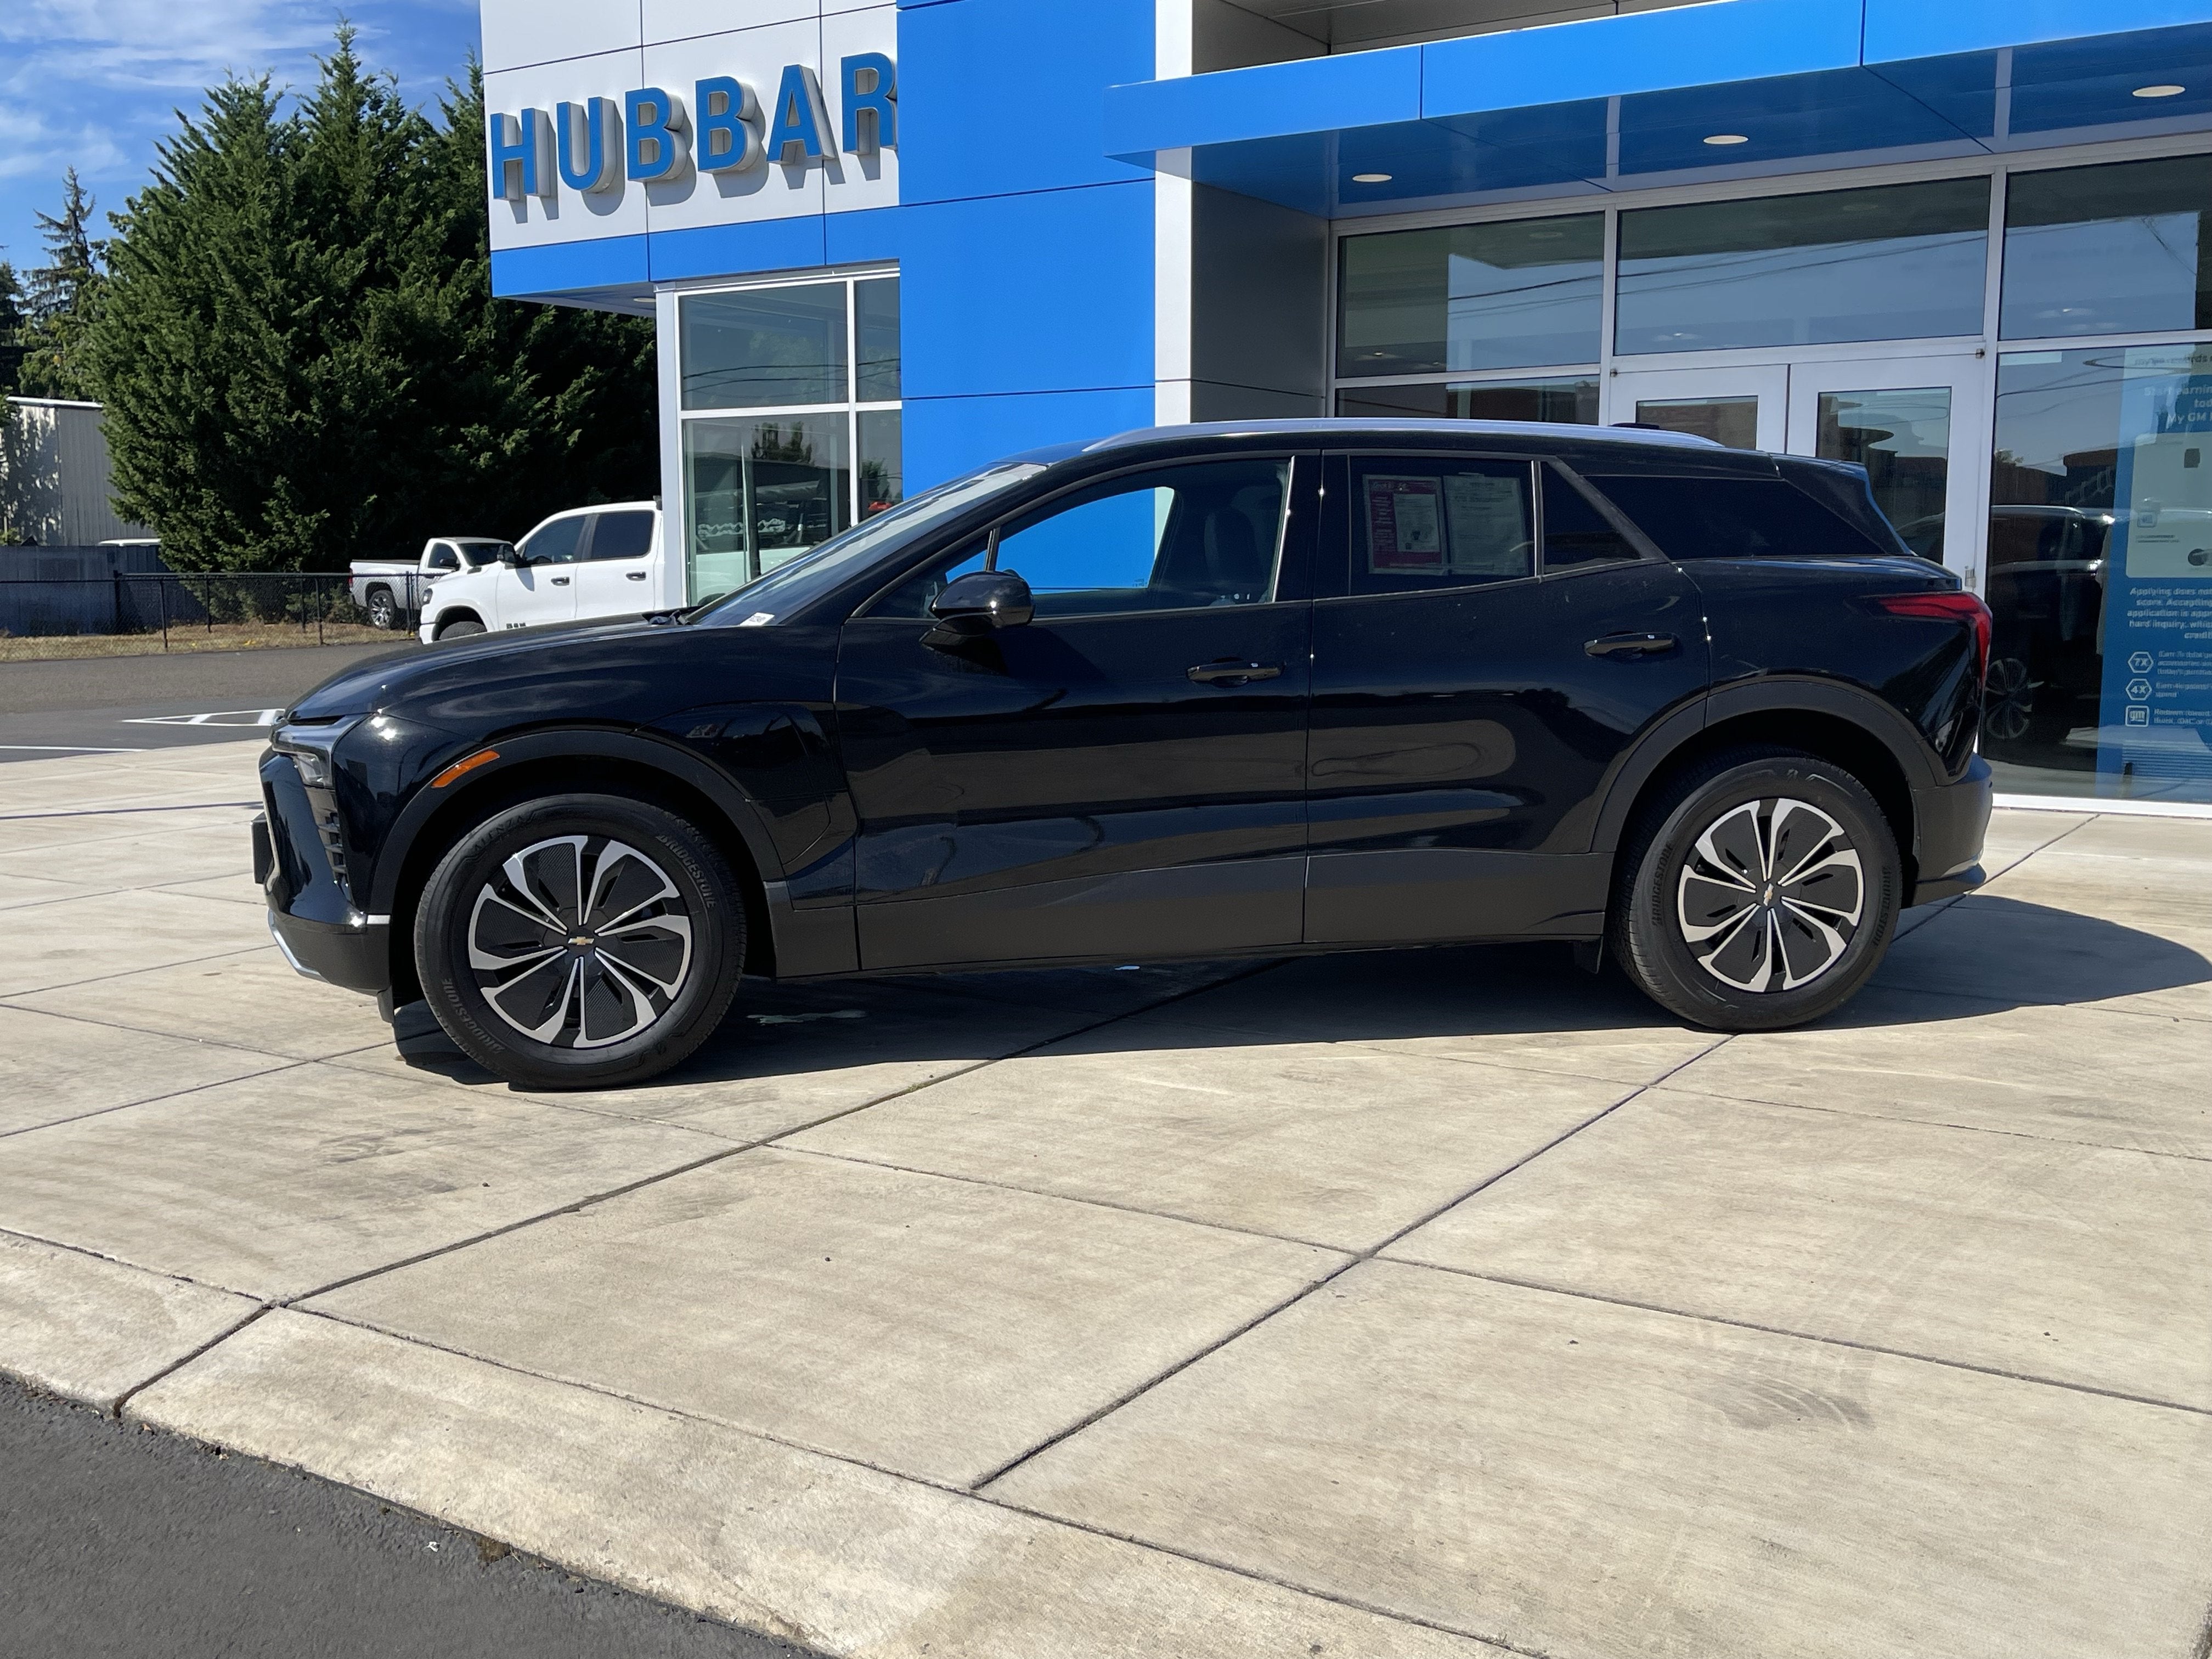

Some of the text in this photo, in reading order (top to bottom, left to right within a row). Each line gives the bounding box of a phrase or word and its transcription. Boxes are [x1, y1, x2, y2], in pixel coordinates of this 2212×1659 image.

[490, 52, 897, 201] HUBBAR
[655, 835, 716, 909] BRIDGESTONE
[1651, 840, 1674, 927] BRIDGESTONE
[441, 978, 505, 1052] BRIDGESTONE
